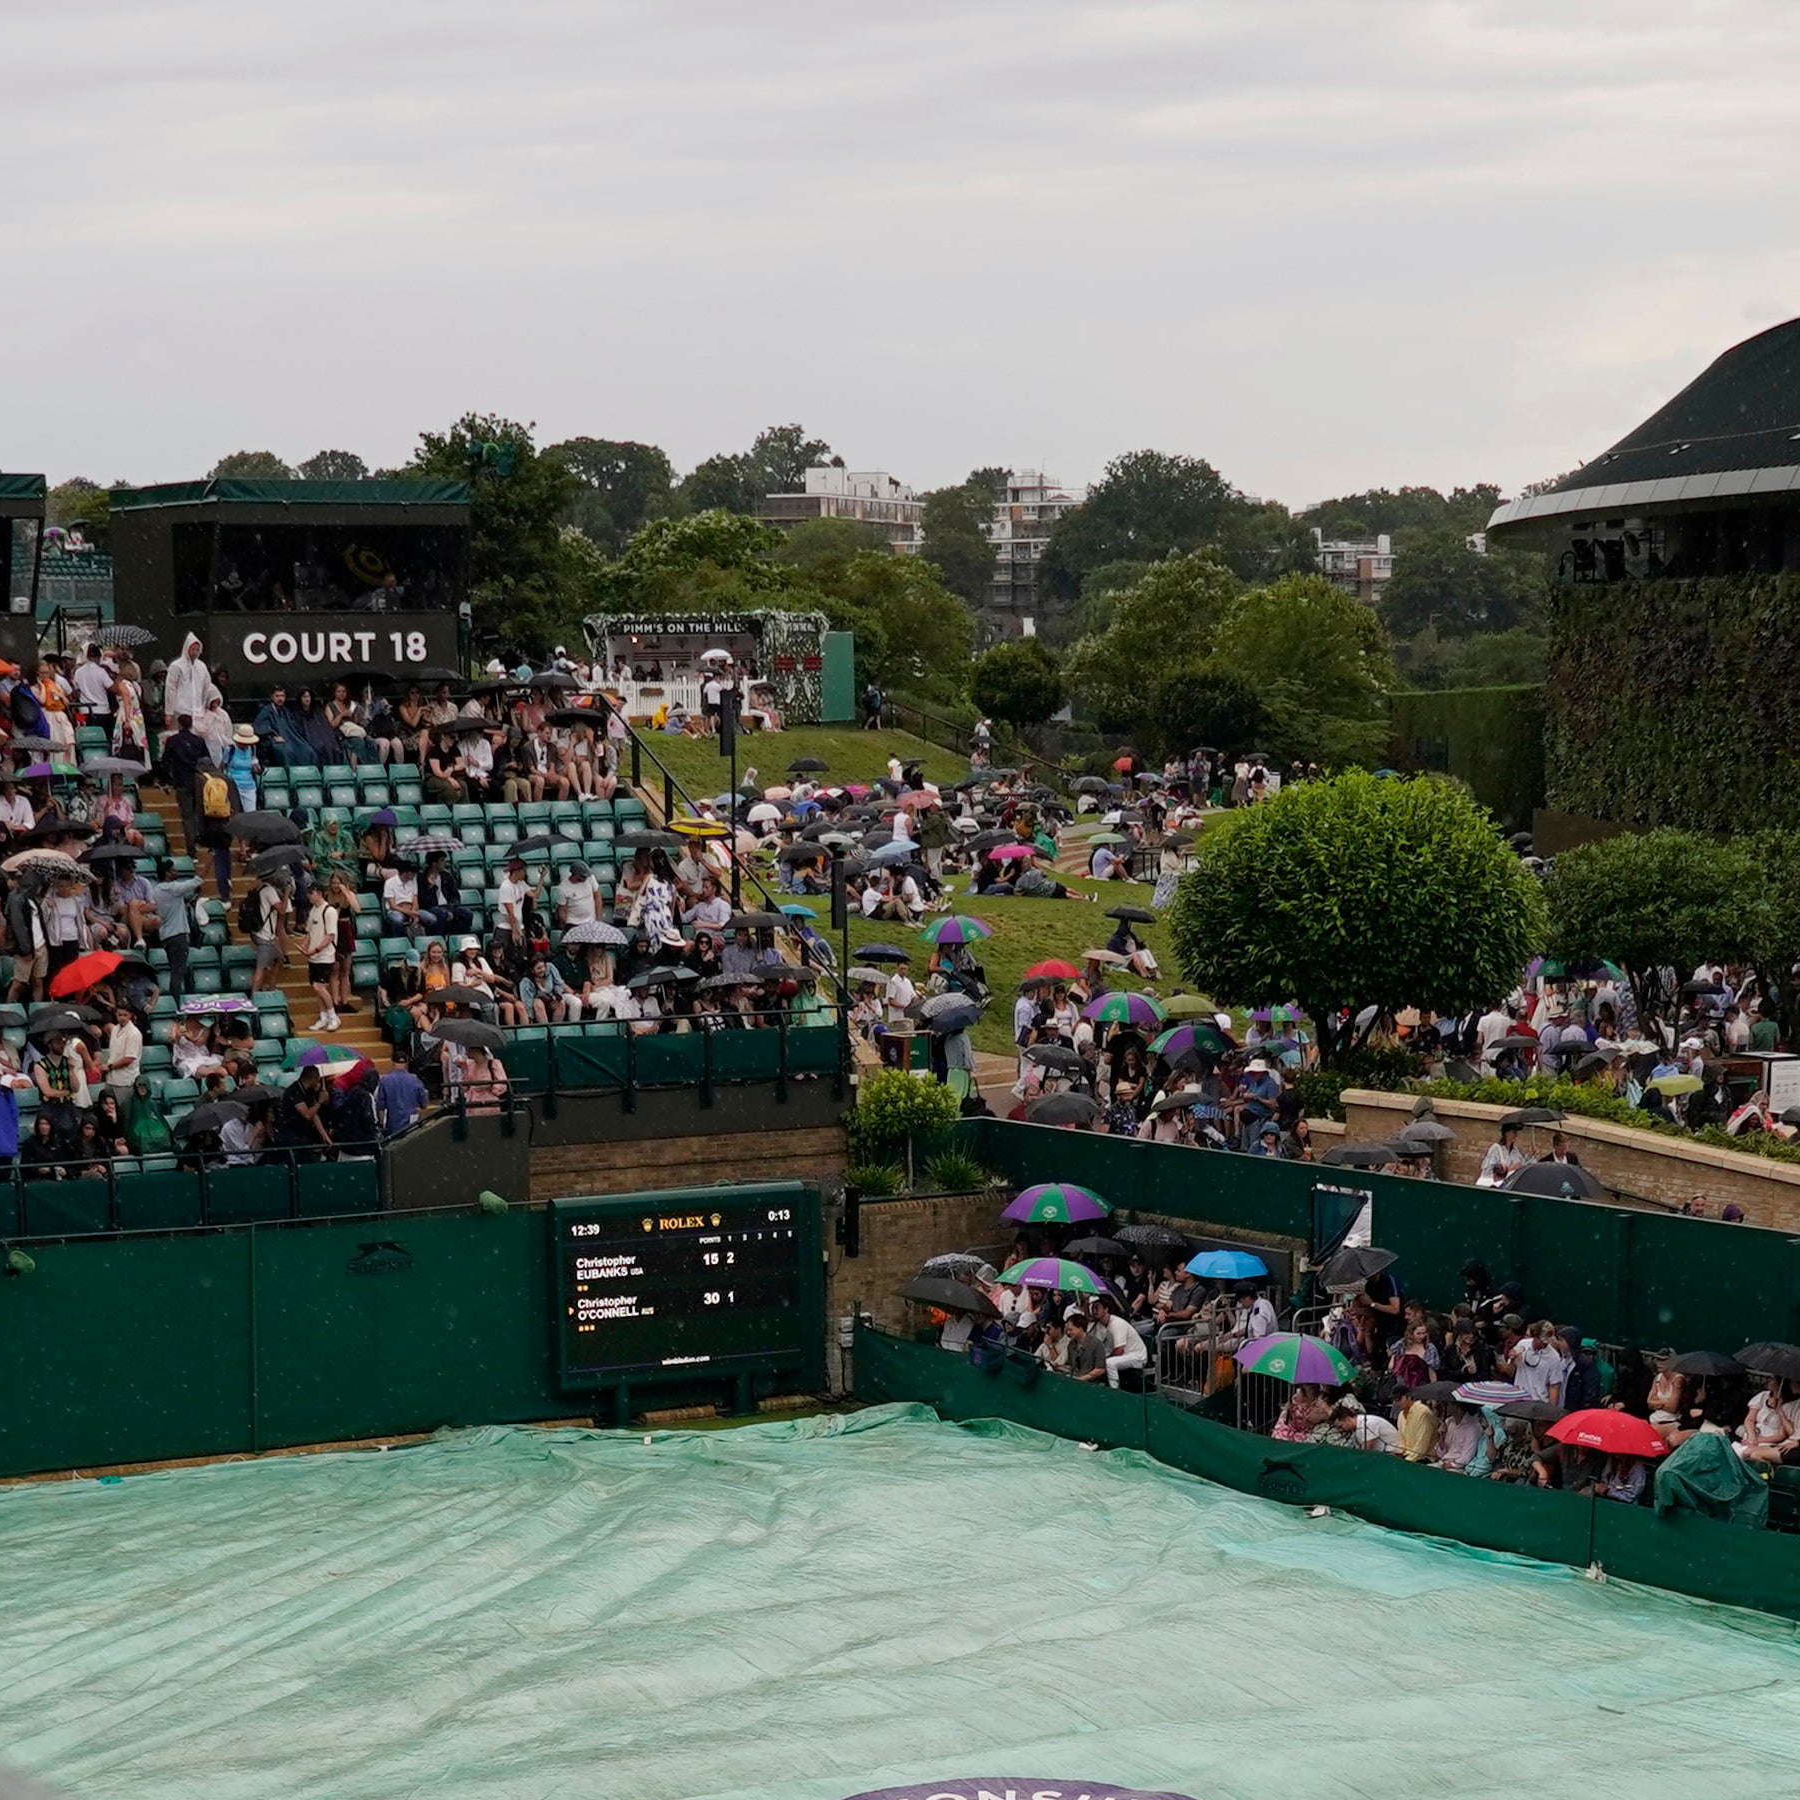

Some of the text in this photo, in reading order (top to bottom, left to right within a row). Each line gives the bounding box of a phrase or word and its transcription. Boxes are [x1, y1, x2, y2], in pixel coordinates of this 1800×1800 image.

[623, 623, 740, 633] PIMM'S ON THE HILL
[243, 631, 427, 663] COURT 18
[768, 1209, 790, 1222] 0:13
[659, 1216, 705, 1230] ROLEX
[571, 1224, 600, 1236] 12:39
[699, 1236, 721, 1244] POINTS
[576, 1255, 636, 1268] Christopher
[703, 1252, 734, 1266] 15 2
[577, 1266, 628, 1280] EUBANKS
[577, 1296, 637, 1309] Christopher
[704, 1291, 734, 1305] 30 1
[578, 1306, 639, 1321] O'CONNELL
